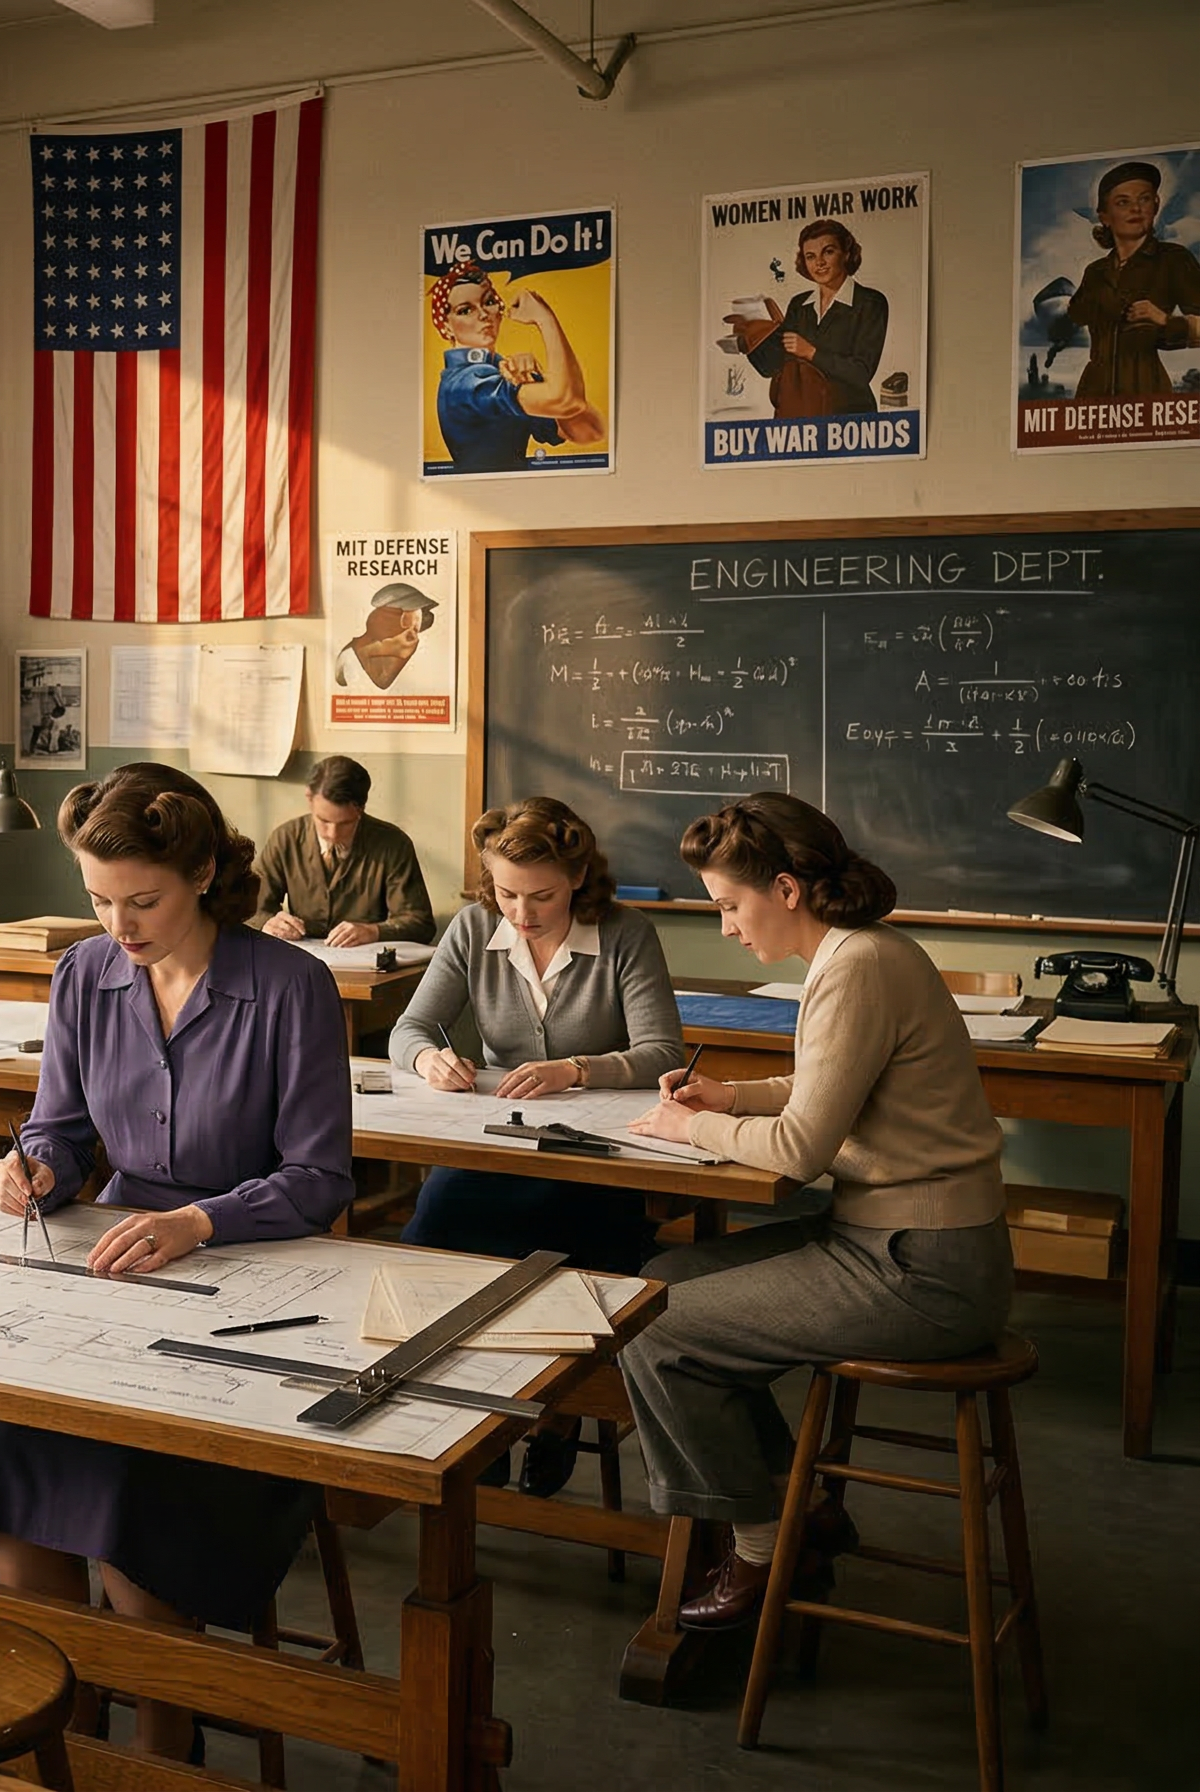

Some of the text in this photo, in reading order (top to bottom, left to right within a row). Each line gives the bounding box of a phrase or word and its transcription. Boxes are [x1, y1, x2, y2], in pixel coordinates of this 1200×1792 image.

[711, 185, 919, 228] WOMEN IN WAR WORK
[431, 219, 603, 265] We Can Do It!
[1024, 399, 1200, 433] MIT DEFENSE RESE
[713, 419, 911, 457] BUY WAR BONDS
[336, 538, 449, 556] MIT DEFENSE
[347, 559, 438, 576] RESEARCH
[690, 549, 1104, 590] ENGINEERING DEPT.
